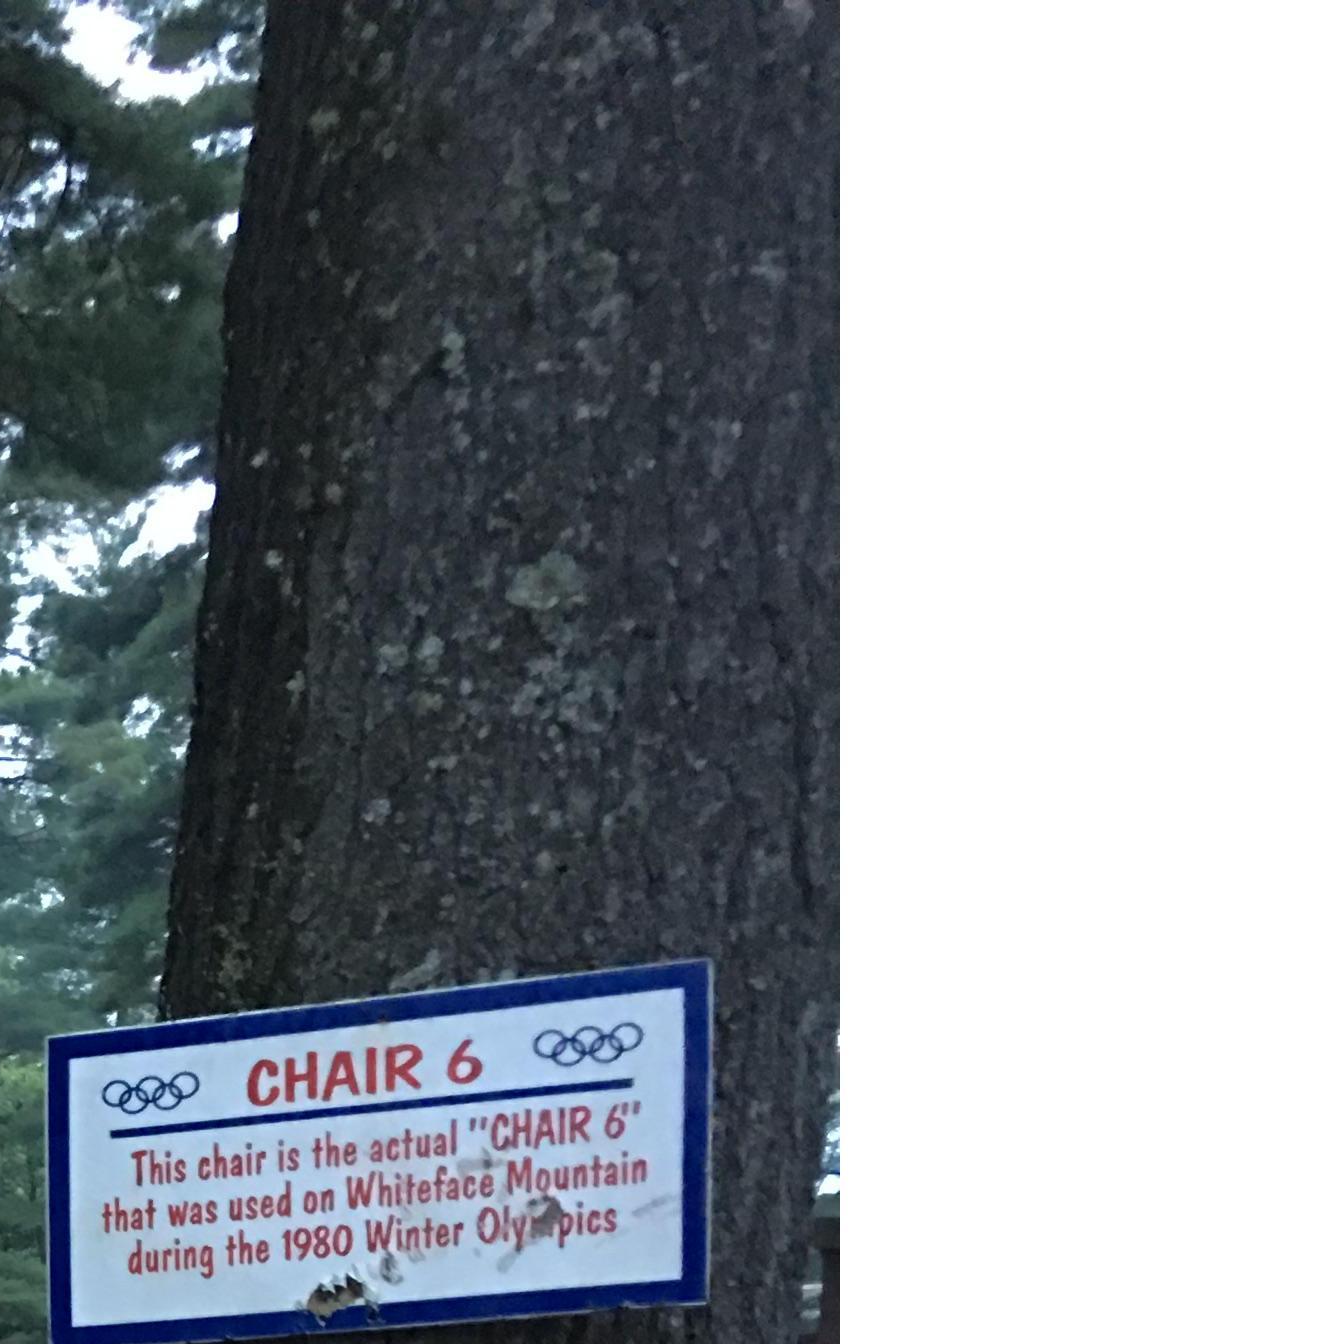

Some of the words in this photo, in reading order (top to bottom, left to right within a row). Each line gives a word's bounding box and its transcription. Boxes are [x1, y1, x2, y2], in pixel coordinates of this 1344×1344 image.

[247, 1043, 423, 1107] CHAIR
[447, 1036, 483, 1084] 6
[131, 1150, 186, 1185] This
[199, 1142, 266, 1180] chair
[278, 1139, 299, 1171] is
[312, 1131, 358, 1168] the
[370, 1118, 458, 1163] actual
[469, 1106, 591, 1150] "CHAIR
[605, 1101, 641, 1139] 6"
[102, 1197, 156, 1233] that
[168, 1200, 217, 1227] was
[230, 1180, 292, 1221] used
[303, 1188, 334, 1214] on
[347, 1166, 495, 1211] Whiteface
[507, 1151, 648, 1194] Mountain
[128, 1239, 215, 1279] during
[226, 1230, 270, 1267] the
[283, 1225, 354, 1261] 1980
[366, 1215, 464, 1253] Winter
[478, 1201, 617, 1252] Olypics
